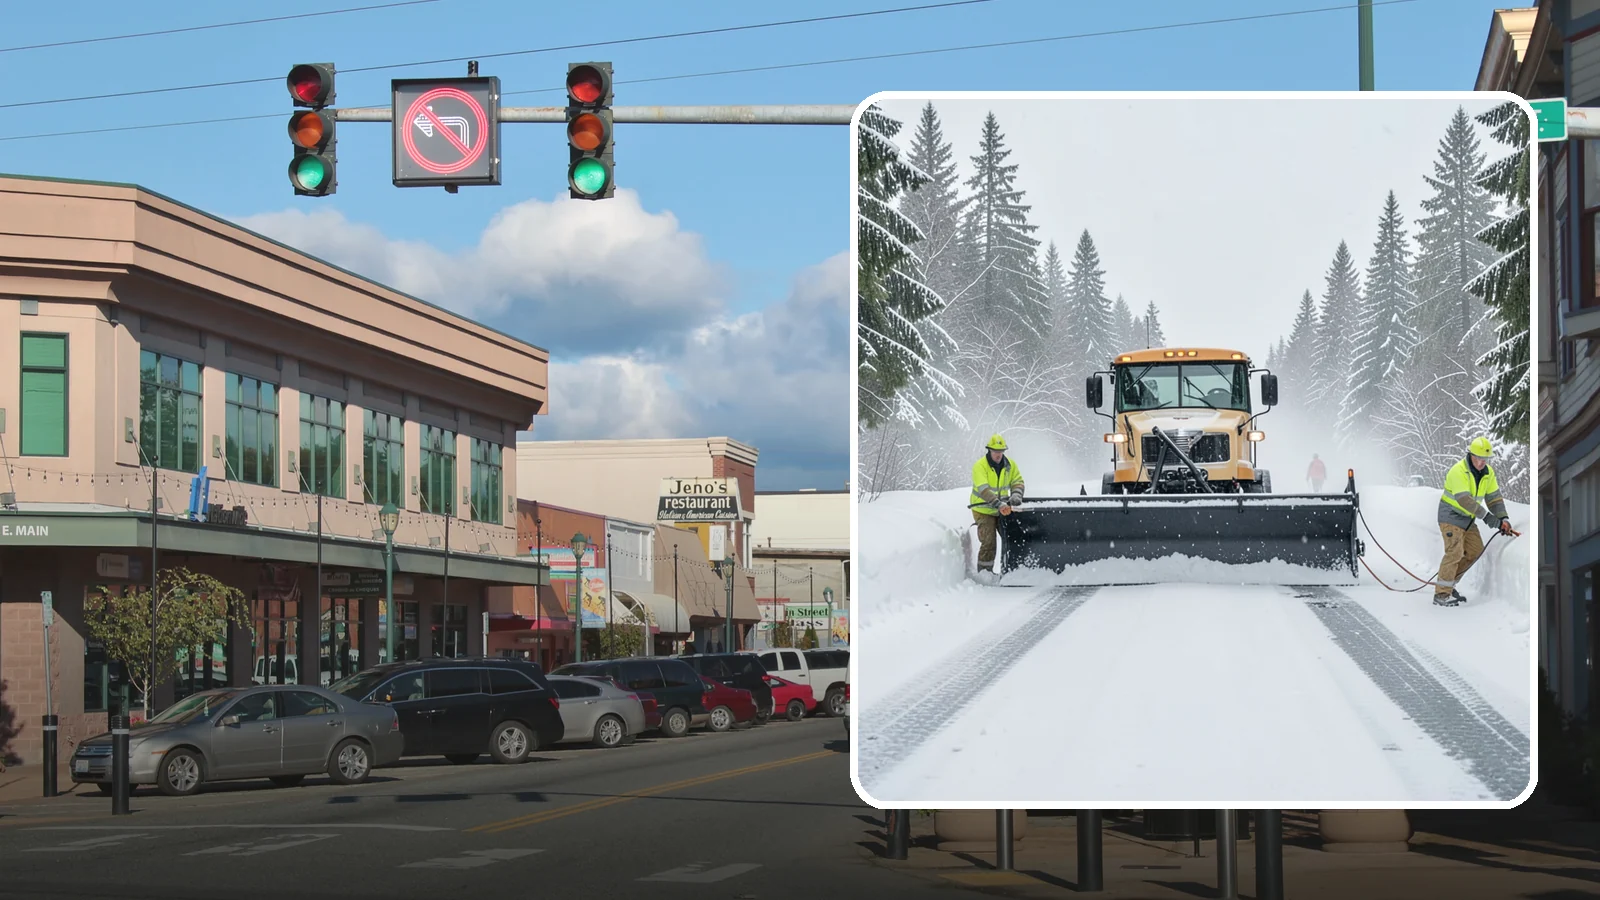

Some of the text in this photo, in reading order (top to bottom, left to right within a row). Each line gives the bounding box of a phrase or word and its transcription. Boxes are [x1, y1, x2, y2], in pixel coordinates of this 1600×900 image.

[669, 480, 728, 495] Jeno's
[665, 496, 731, 509] restaurant
[658, 509, 682, 519] Italian
[686, 509, 714, 519] American
[715, 509, 738, 519] Cuisine
[2, 525, 49, 536] E. MAIN
[797, 607, 828, 616] Street
